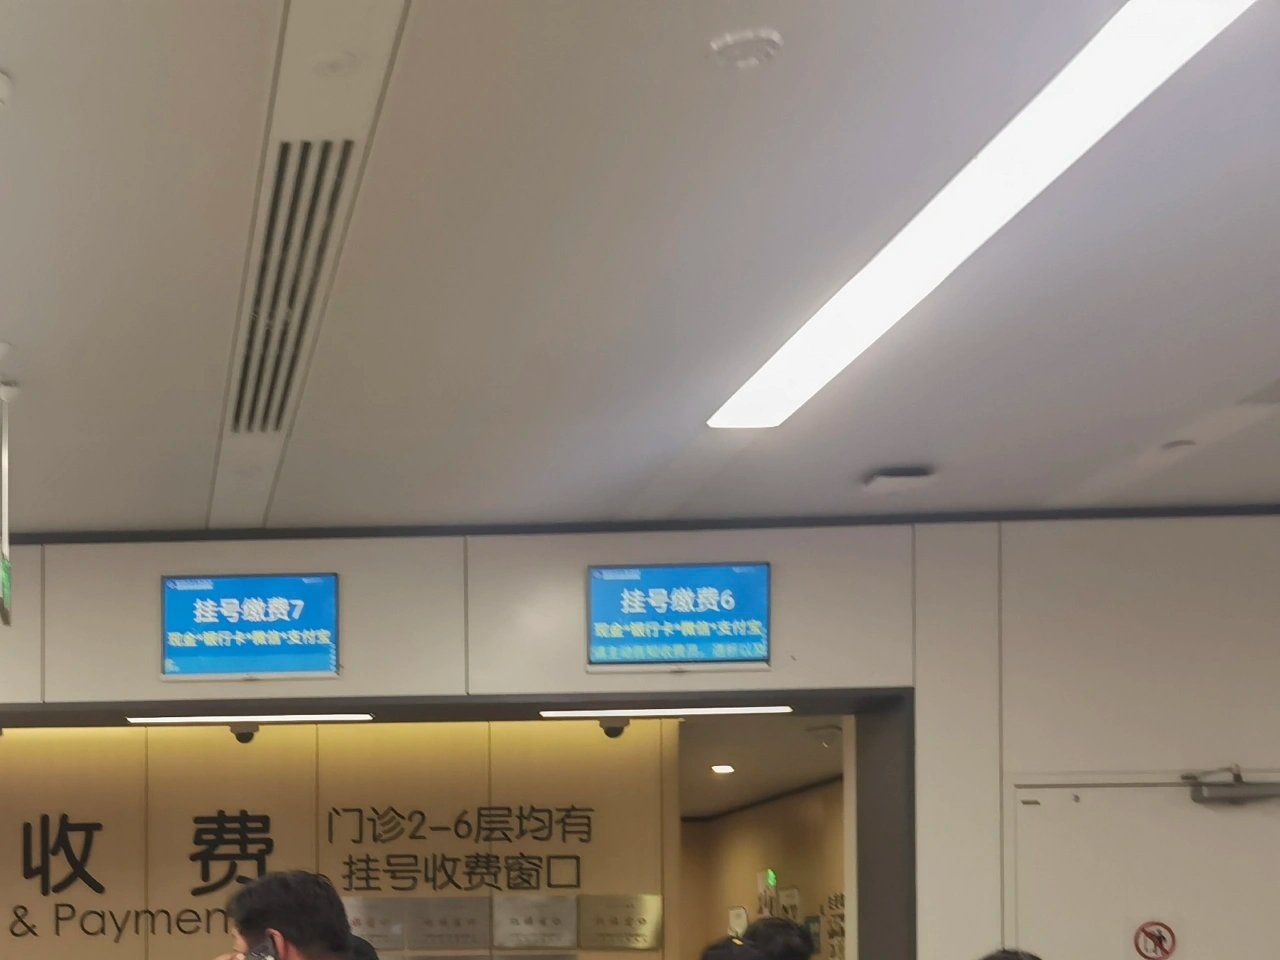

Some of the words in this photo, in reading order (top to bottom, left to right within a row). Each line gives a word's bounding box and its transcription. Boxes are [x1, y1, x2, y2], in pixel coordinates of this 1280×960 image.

[193, 596, 305, 623] 挂号缴费7
[620, 586, 736, 614] 挂号缴费6
[327, 805, 595, 844] 门诊2-6层均有
[342, 852, 581, 891] 挂号收费窗口
[8, 904, 38, 938] &
[54, 903, 229, 945] Paymen
